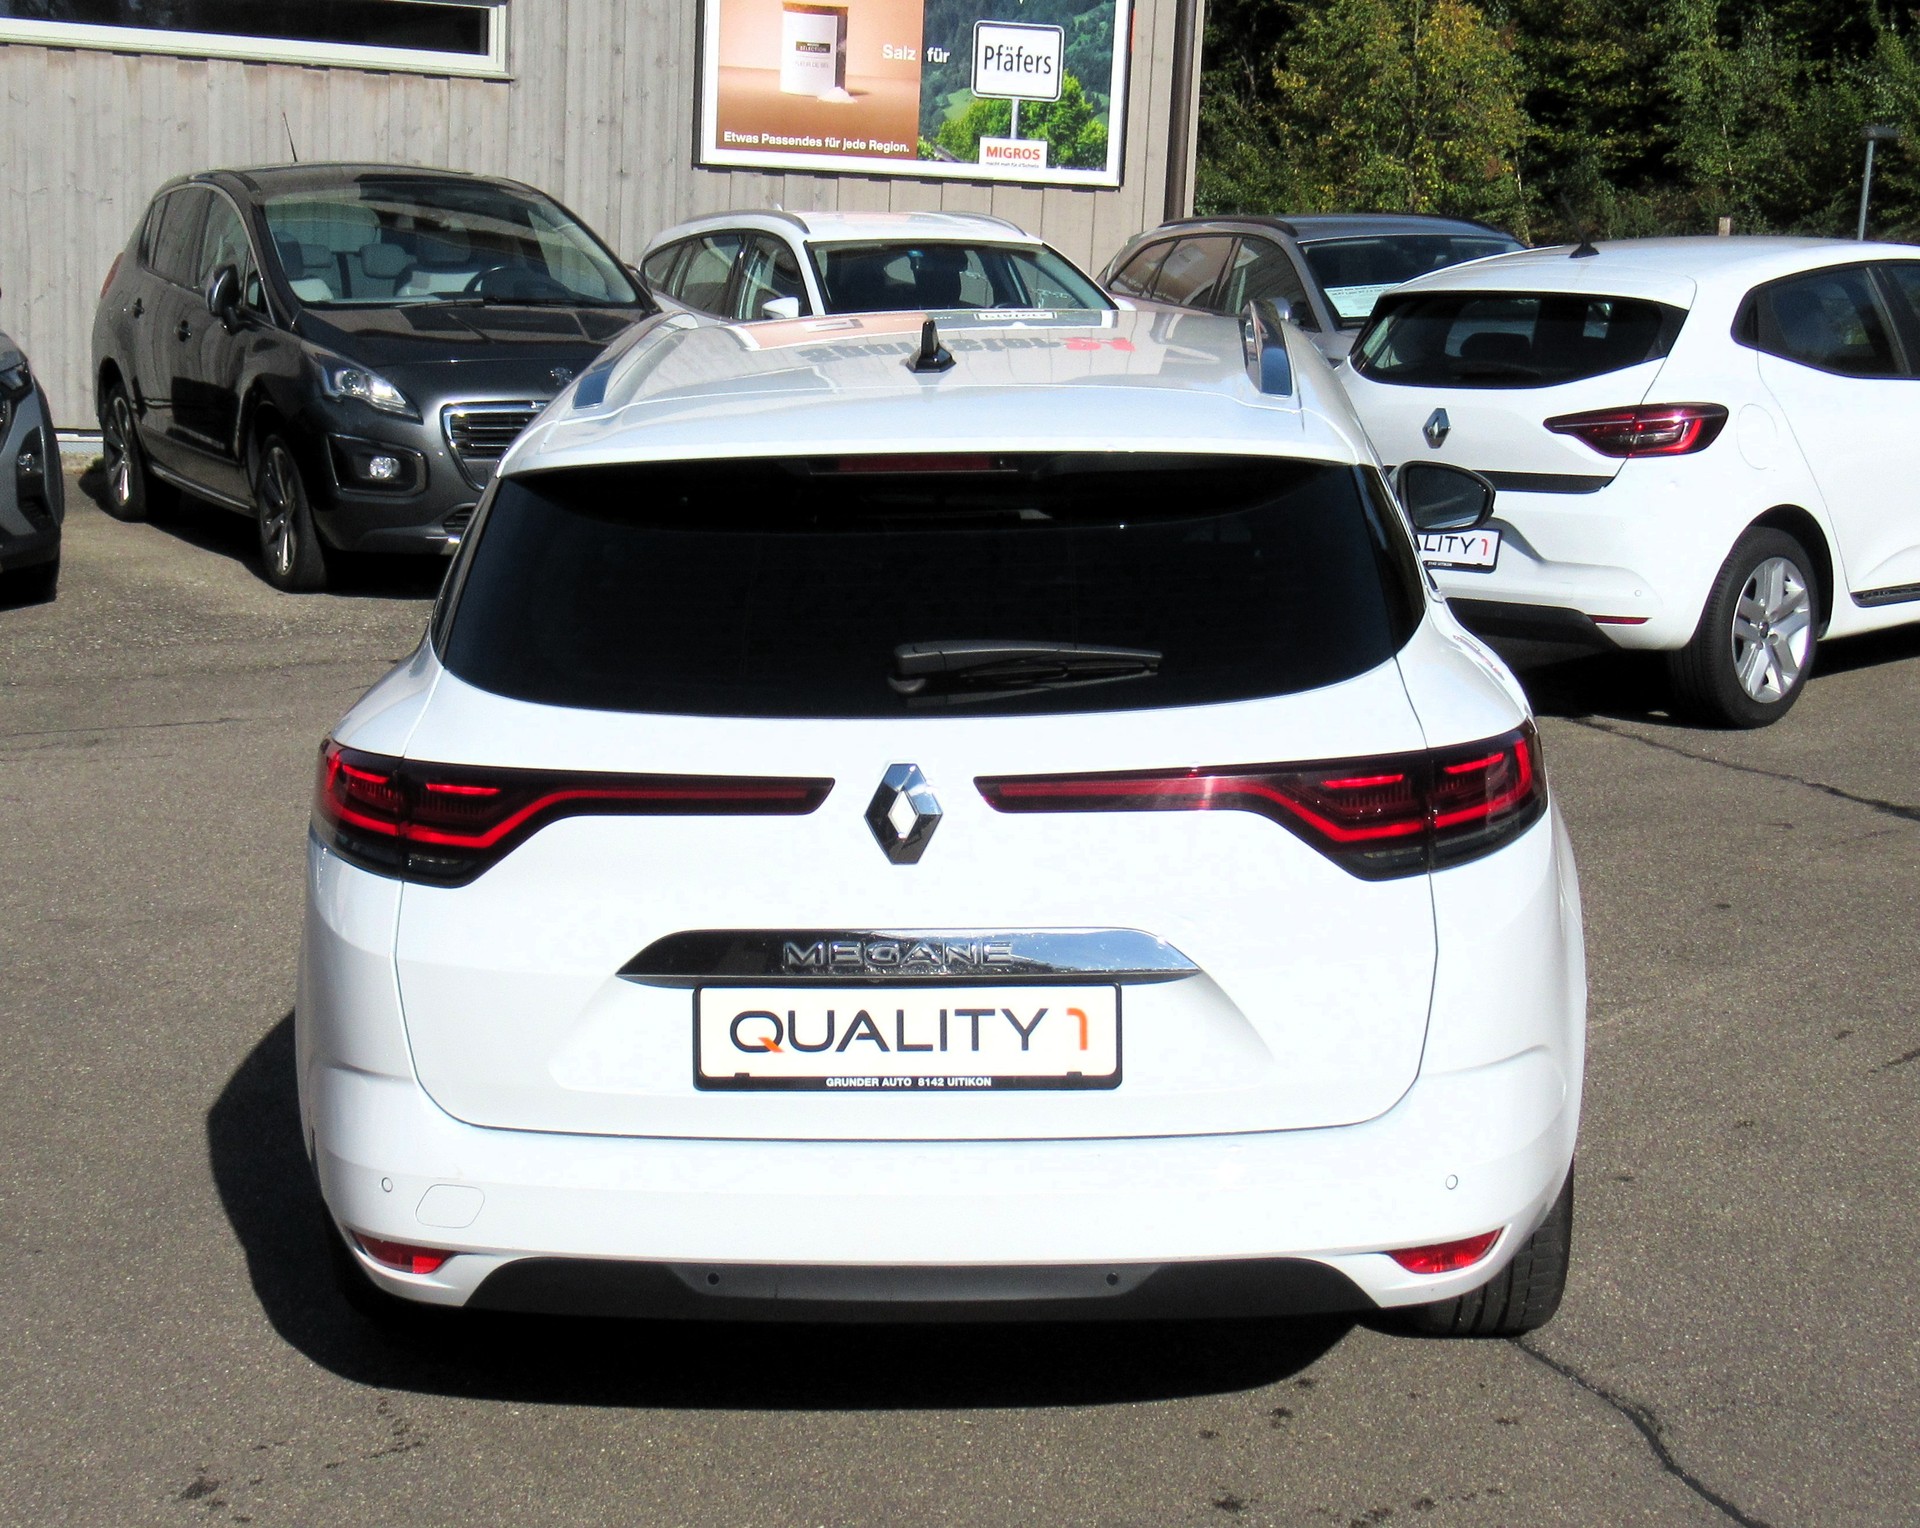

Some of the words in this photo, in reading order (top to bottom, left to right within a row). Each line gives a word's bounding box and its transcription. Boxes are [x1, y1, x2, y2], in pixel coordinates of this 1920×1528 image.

[882, 44, 916, 61] Salz
[926, 46, 951, 63] für
[984, 44, 1052, 75] Pfäfers
[723, 131, 759, 144] Etwas
[761, 133, 822, 147] Passendes
[824, 136, 840, 148] für
[842, 138, 866, 151] jede
[868, 139, 910, 153] Region.
[986, 145, 1041, 160] MIGROS
[1418, 534, 1475, 554] LITY
[783, 940, 1013, 966] MEGANE
[729, 1008, 1049, 1053] QUALITY
[1066, 1007, 1088, 1051] 1
[825, 1077, 879, 1087] GRUNDER
[881, 1077, 912, 1087] AUTO
[917, 1077, 944, 1087] 8142
[947, 1077, 992, 1087] UITIKON
